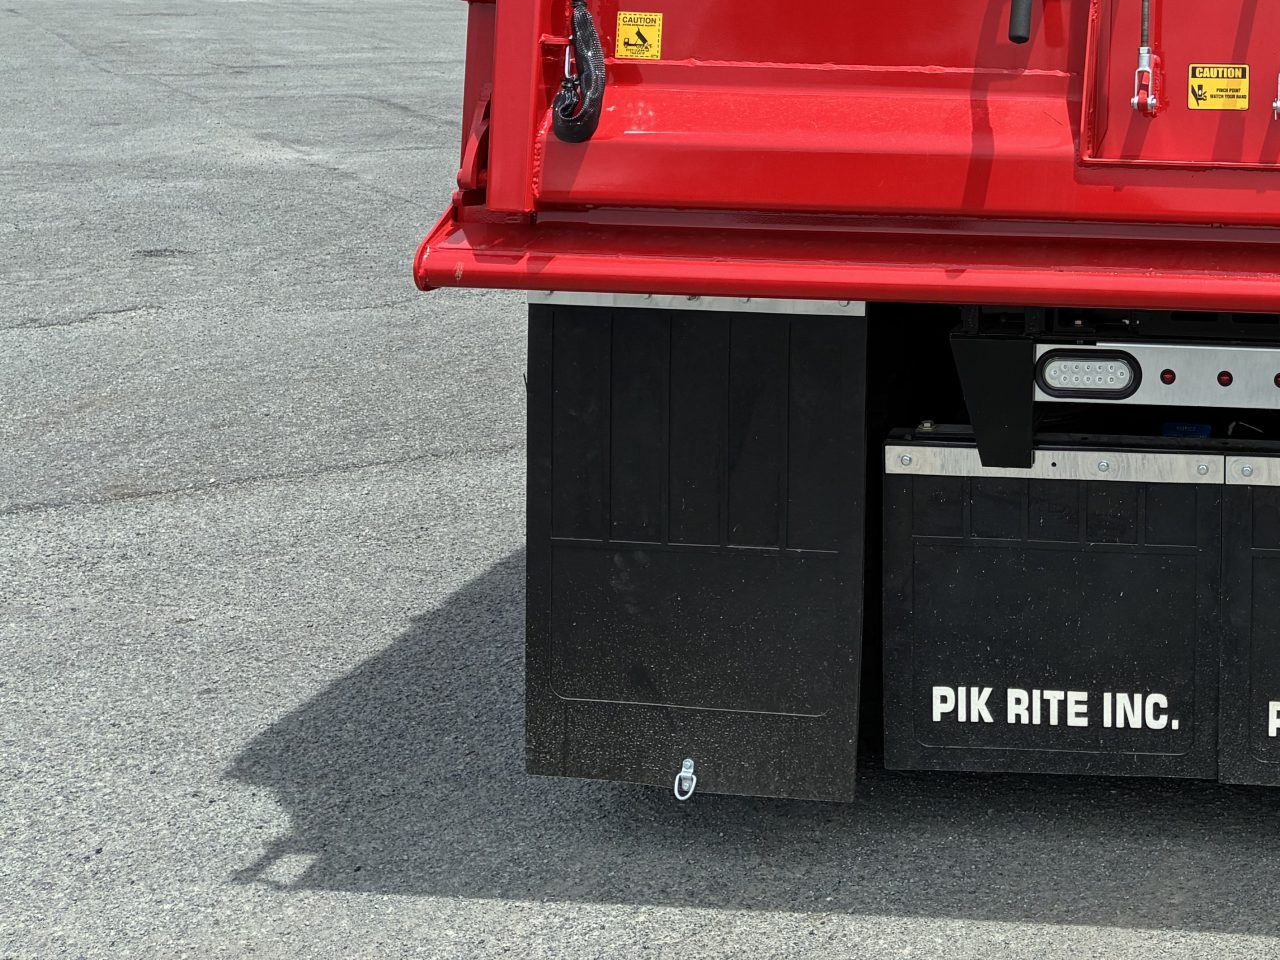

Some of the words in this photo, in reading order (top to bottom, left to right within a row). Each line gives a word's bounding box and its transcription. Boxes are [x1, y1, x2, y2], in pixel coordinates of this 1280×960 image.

[622, 16, 657, 24] CAUTION
[1195, 67, 1242, 78] CAUTION
[932, 686, 994, 723] PIK
[1007, 688, 1089, 727] RITE
[1103, 692, 1179, 730] INC.
